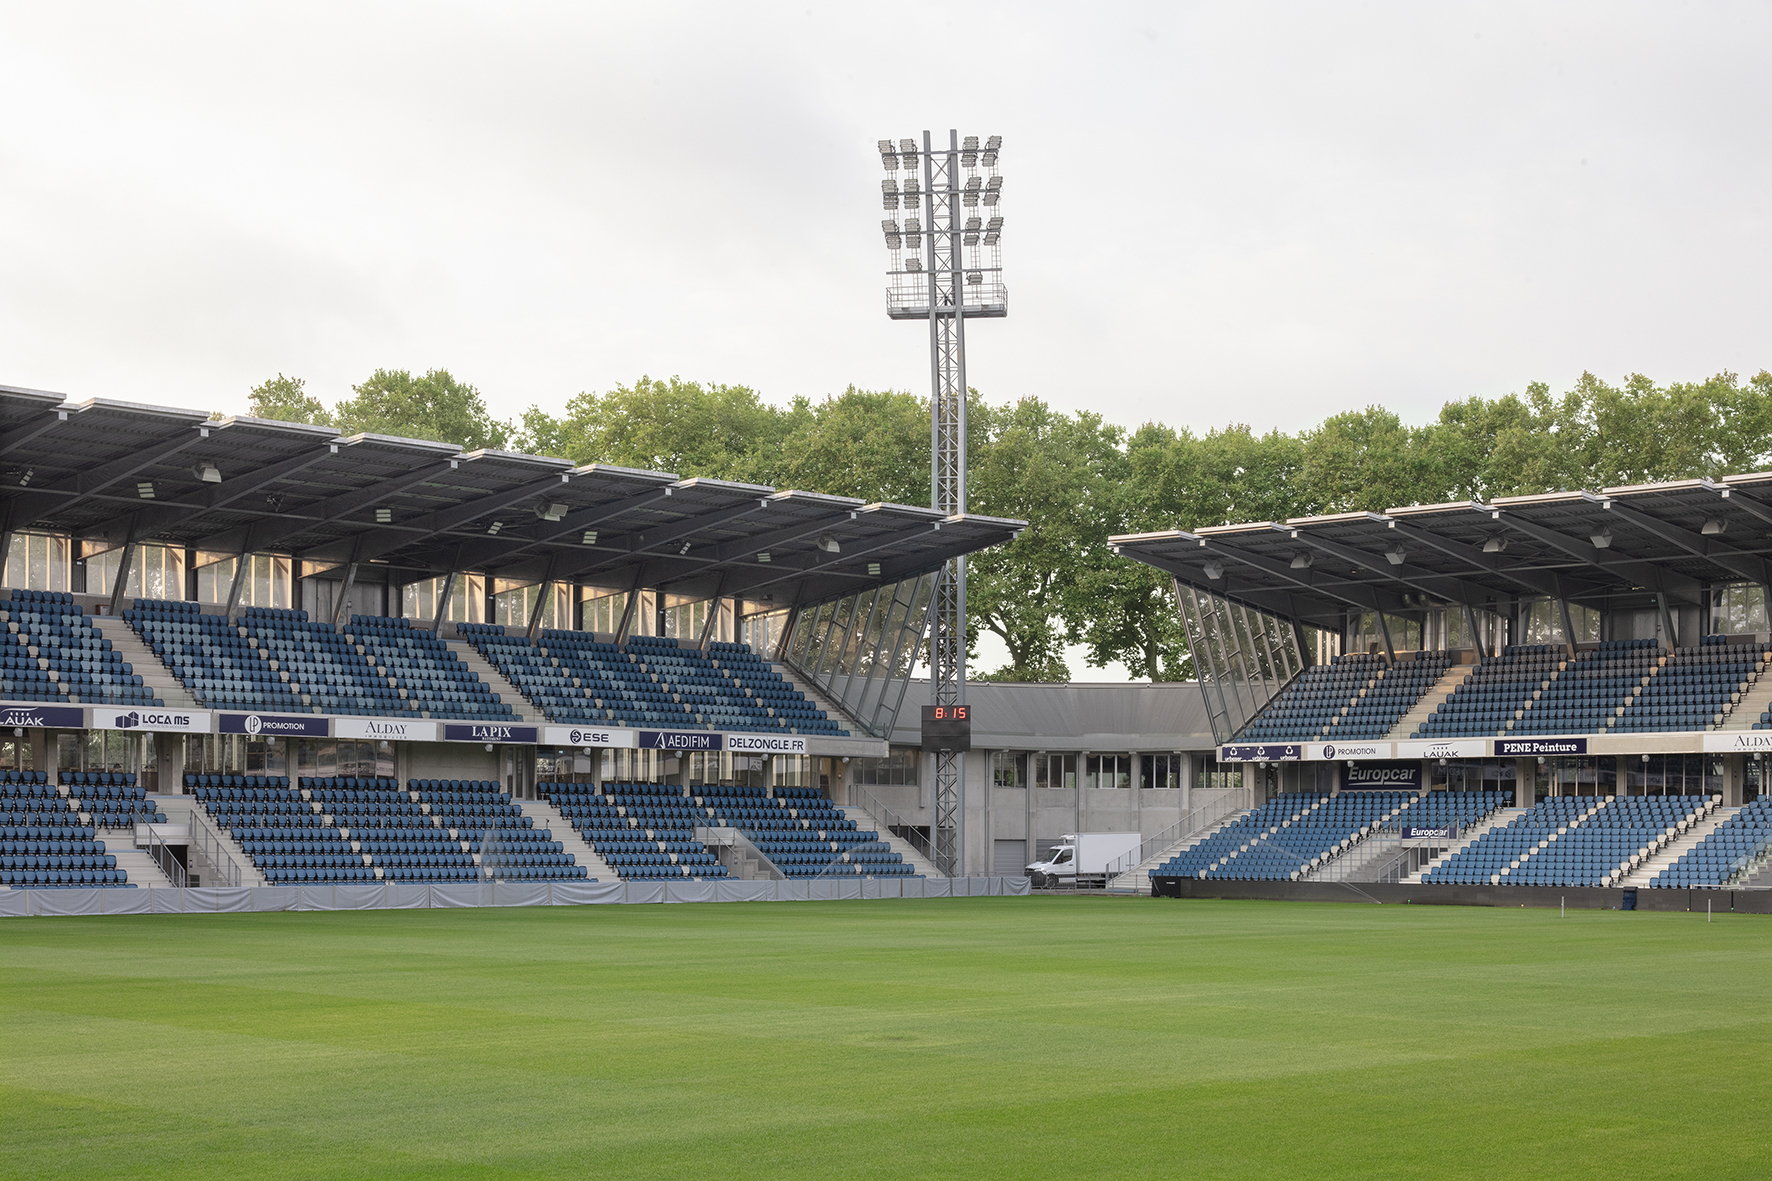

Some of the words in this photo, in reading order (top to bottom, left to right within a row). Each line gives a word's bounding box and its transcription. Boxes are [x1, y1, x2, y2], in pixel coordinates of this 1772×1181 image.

[935, 707, 966, 719] 8:15
[0, 716, 44, 726] AUAK
[262, 721, 305, 730] PROMOTION
[365, 720, 407, 734] ALDAY
[472, 725, 511, 738] LAPIX
[583, 733, 609, 743] ESE
[667, 734, 710, 748] AEDIFIM
[729, 737, 804, 751] DELZONGLE.FR
[1734, 735, 1772, 747] ALDA
[1337, 747, 1376, 756] PROMOTION
[1503, 742, 1532, 753] PENE
[1533, 742, 1578, 752] Peinture
[1348, 766, 1416, 784] Europcar
[1410, 827, 1448, 837] Europcar
